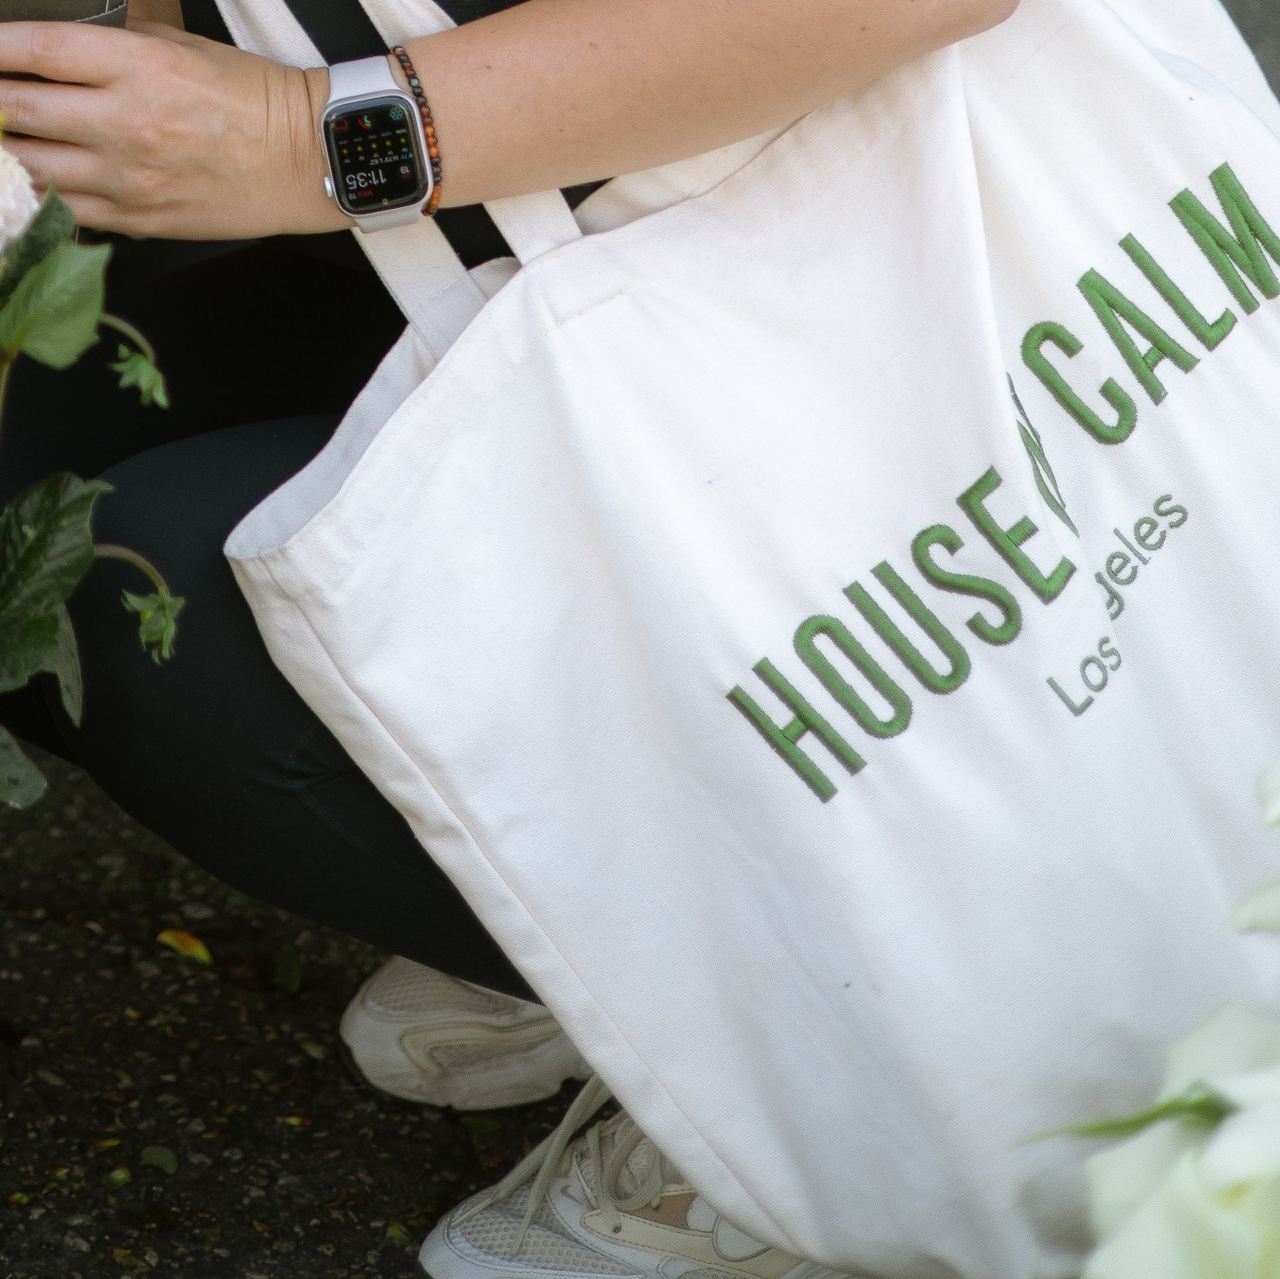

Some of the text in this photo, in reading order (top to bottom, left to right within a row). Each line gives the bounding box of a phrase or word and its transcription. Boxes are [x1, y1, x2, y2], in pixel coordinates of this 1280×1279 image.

[345, 169, 387, 190] 11:35
[725, 160, 1280, 804] HOUSE CALM
[1046, 636, 1122, 717] Los
